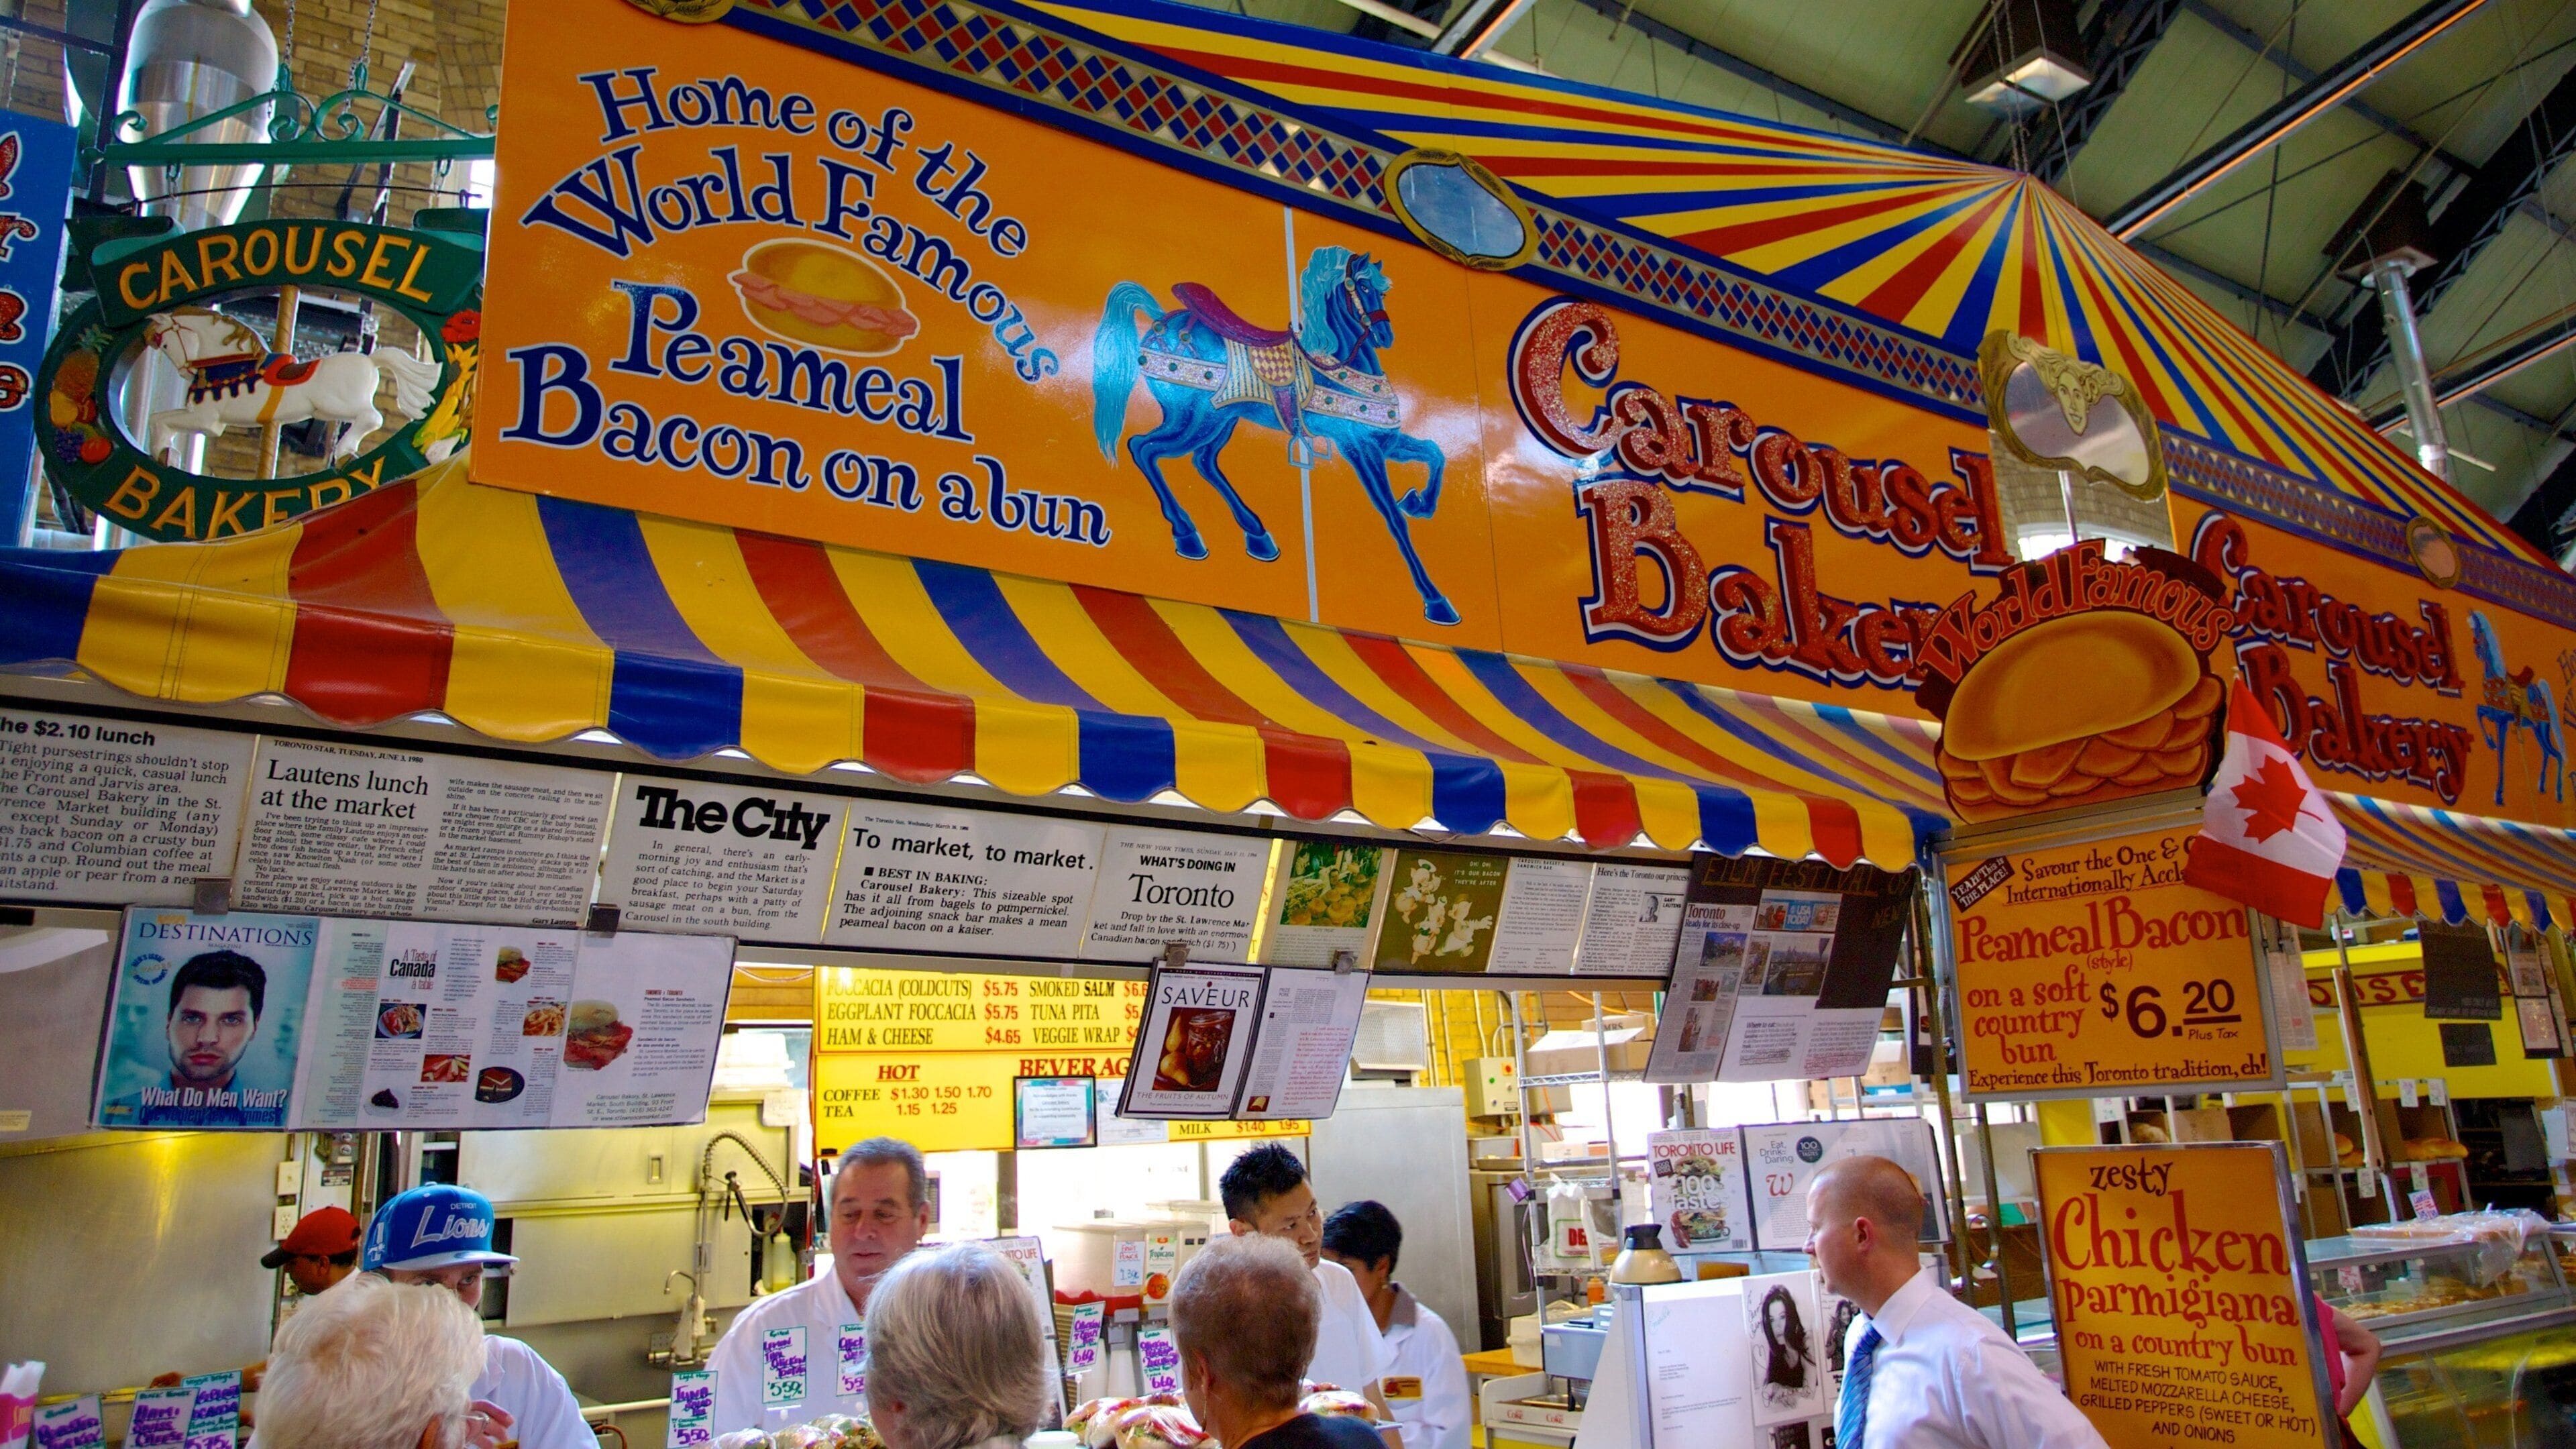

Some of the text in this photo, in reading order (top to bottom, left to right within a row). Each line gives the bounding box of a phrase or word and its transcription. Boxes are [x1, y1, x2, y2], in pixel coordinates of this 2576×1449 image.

[577, 66, 1029, 259] Home of the
[118, 225, 433, 310] CAROUSEL
[518, 144, 1061, 384] World Famous
[608, 278, 976, 444] Peameal
[499, 341, 1113, 547] Bacon on a bun
[1507, 294, 2015, 578] Carousel
[1572, 471, 1947, 693] Baker
[1915, 538, 2237, 686] World Famous
[2189, 508, 2466, 698] Carousel
[34, 719, 91, 739] $2.10
[96, 727, 156, 746] lunch
[2231, 637, 2475, 806] Bakery
[268, 759, 429, 796] Lautens lunch
[260, 788, 417, 819] at the market
[636, 785, 831, 851] The City
[853, 827, 881, 849] To
[892, 837, 974, 861] market,
[985, 844, 1006, 861] to
[1140, 855, 1236, 872] WHAT'S DOING IN
[1597, 866, 1619, 879] Here's
[1621, 868, 1629, 877] the
[1630, 868, 1654, 880] Toronto
[1655, 872, 1666, 881] our
[2021, 858, 2080, 882] Savour
[2085, 849, 2112, 871] the
[2117, 845, 2156, 865] One
[2161, 838, 2179, 859] &
[878, 867, 989, 885] BEST IN BAKING:
[1128, 872, 1234, 909] Toronto
[1951, 857, 2004, 900] YEAH! This is
[1959, 866, 2008, 907] THE PLACE!
[2006, 869, 2135, 904] Internationally
[1688, 904, 1725, 920] Toronto
[140, 922, 314, 947] DESTINATIONS
[1957, 895, 2251, 965] Peameal Bacon
[390, 959, 436, 977] Canada
[402, 949, 408, 961] A
[411, 949, 429, 962] Taste
[2086, 949, 2133, 975] (style)
[898, 979, 972, 1000] (COLDCUTS)
[983, 981, 1019, 998] $5.75
[1030, 981, 1115, 998] SMOKED SALM
[1161, 986, 1249, 1007] SAVEUR
[1967, 964, 2091, 1007] on a soft
[827, 1003, 1019, 1021] EGGPLANT FOCCACIA $5.75
[1030, 1004, 1099, 1021] TUNA PITA
[1974, 1008, 2084, 1038] country
[826, 1027, 1021, 1046] HAM & CHEESE $4.65
[1032, 1027, 1120, 1044] VEGGIE WRAP
[2188, 1027, 2239, 1040] Plus Tax
[2000, 1034, 2057, 1065] bun
[877, 1065, 920, 1080] HOT
[1968, 1053, 2267, 1090] Experience this Toronto tradition, eh!
[142, 1087, 288, 1108] What Do Men Want?
[823, 1086, 991, 1102] COFFEE $1.30 1.50 1.70
[823, 1103, 957, 1118] TEA 1.15 1.25
[1179, 1123, 1212, 1134] MILK
[1652, 1142, 1735, 1158] TORONTO LIFE
[1765, 1155, 1794, 1165] Daring
[1770, 1140, 1786, 1149] Eat,
[1678, 1175, 1715, 1195] 100
[2090, 1157, 2174, 1196] zesty
[449, 1201, 478, 1211] DETROIT
[409, 1204, 490, 1249] Lions
[2053, 1189, 2291, 1276] Chicken
[1148, 1249, 1175, 1258] Tropicana
[2059, 1274, 2300, 1330] parmigiana
[2075, 1324, 2298, 1367] on a country bun
[2094, 1360, 2284, 1393] WITH FRESH TOMATO SAUCE,
[2090, 1376, 2295, 1413] MELTED MOZZARELLA CHEESE,
[2080, 1393, 2316, 1437] GRILLED PEPPERS (SWEET OR HOT)
[2151, 1421, 2235, 1444] AND ONIONS
